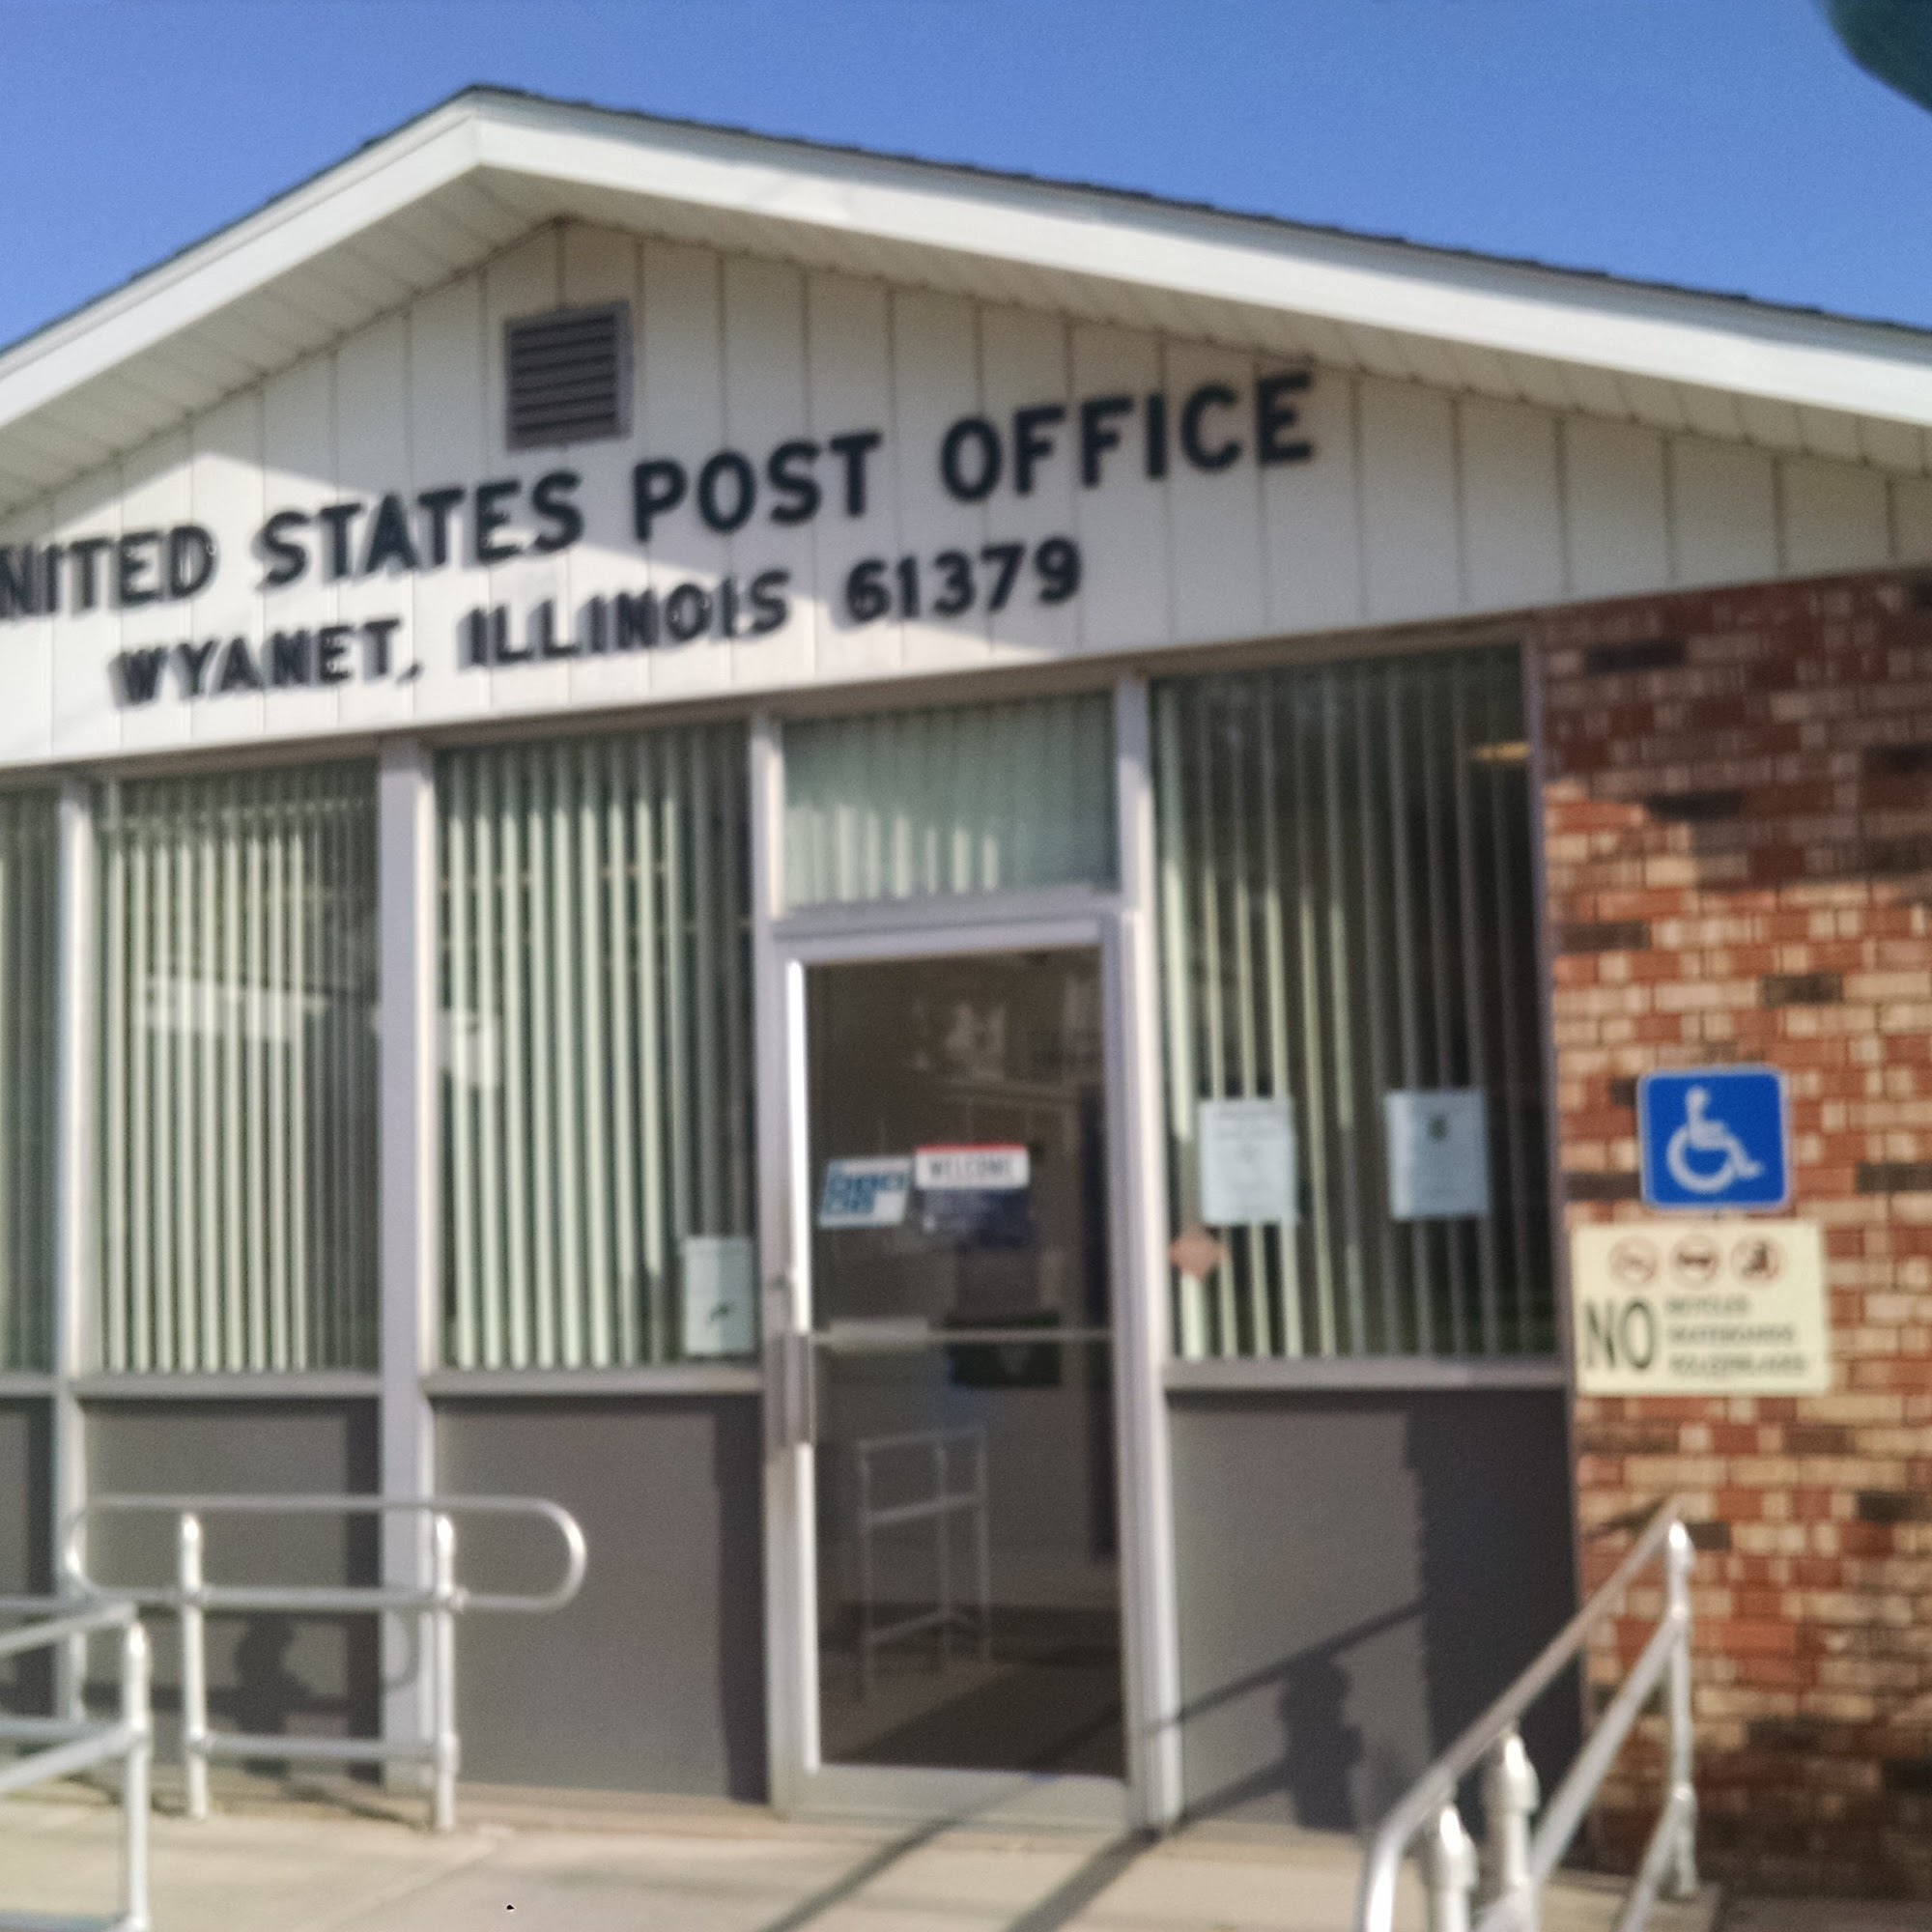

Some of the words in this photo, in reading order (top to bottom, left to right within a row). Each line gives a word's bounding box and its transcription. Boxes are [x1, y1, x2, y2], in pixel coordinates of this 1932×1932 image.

[255, 471, 582, 588] STATES
[633, 429, 883, 544] POST
[939, 370, 1315, 503] OFFICE
[110, 618, 422, 709] WYANET,
[459, 569, 791, 668] ILLINOIS
[843, 535, 1083, 623] 61379
[1584, 1296, 1656, 1372] NO
